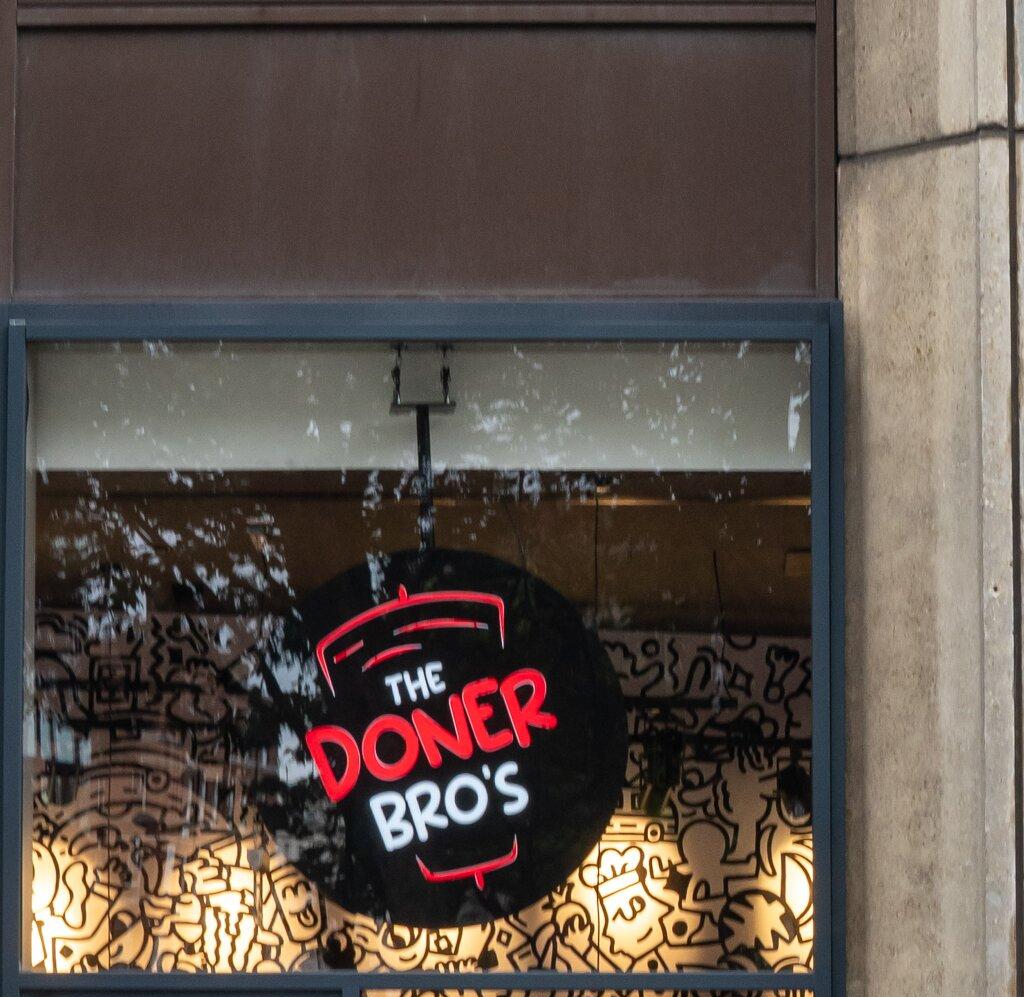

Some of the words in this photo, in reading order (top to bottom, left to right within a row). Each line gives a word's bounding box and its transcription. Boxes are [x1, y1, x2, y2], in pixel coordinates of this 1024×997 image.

[384, 660, 446, 706] THE
[306, 668, 556, 801] DONER
[369, 761, 530, 854] BRO'S
